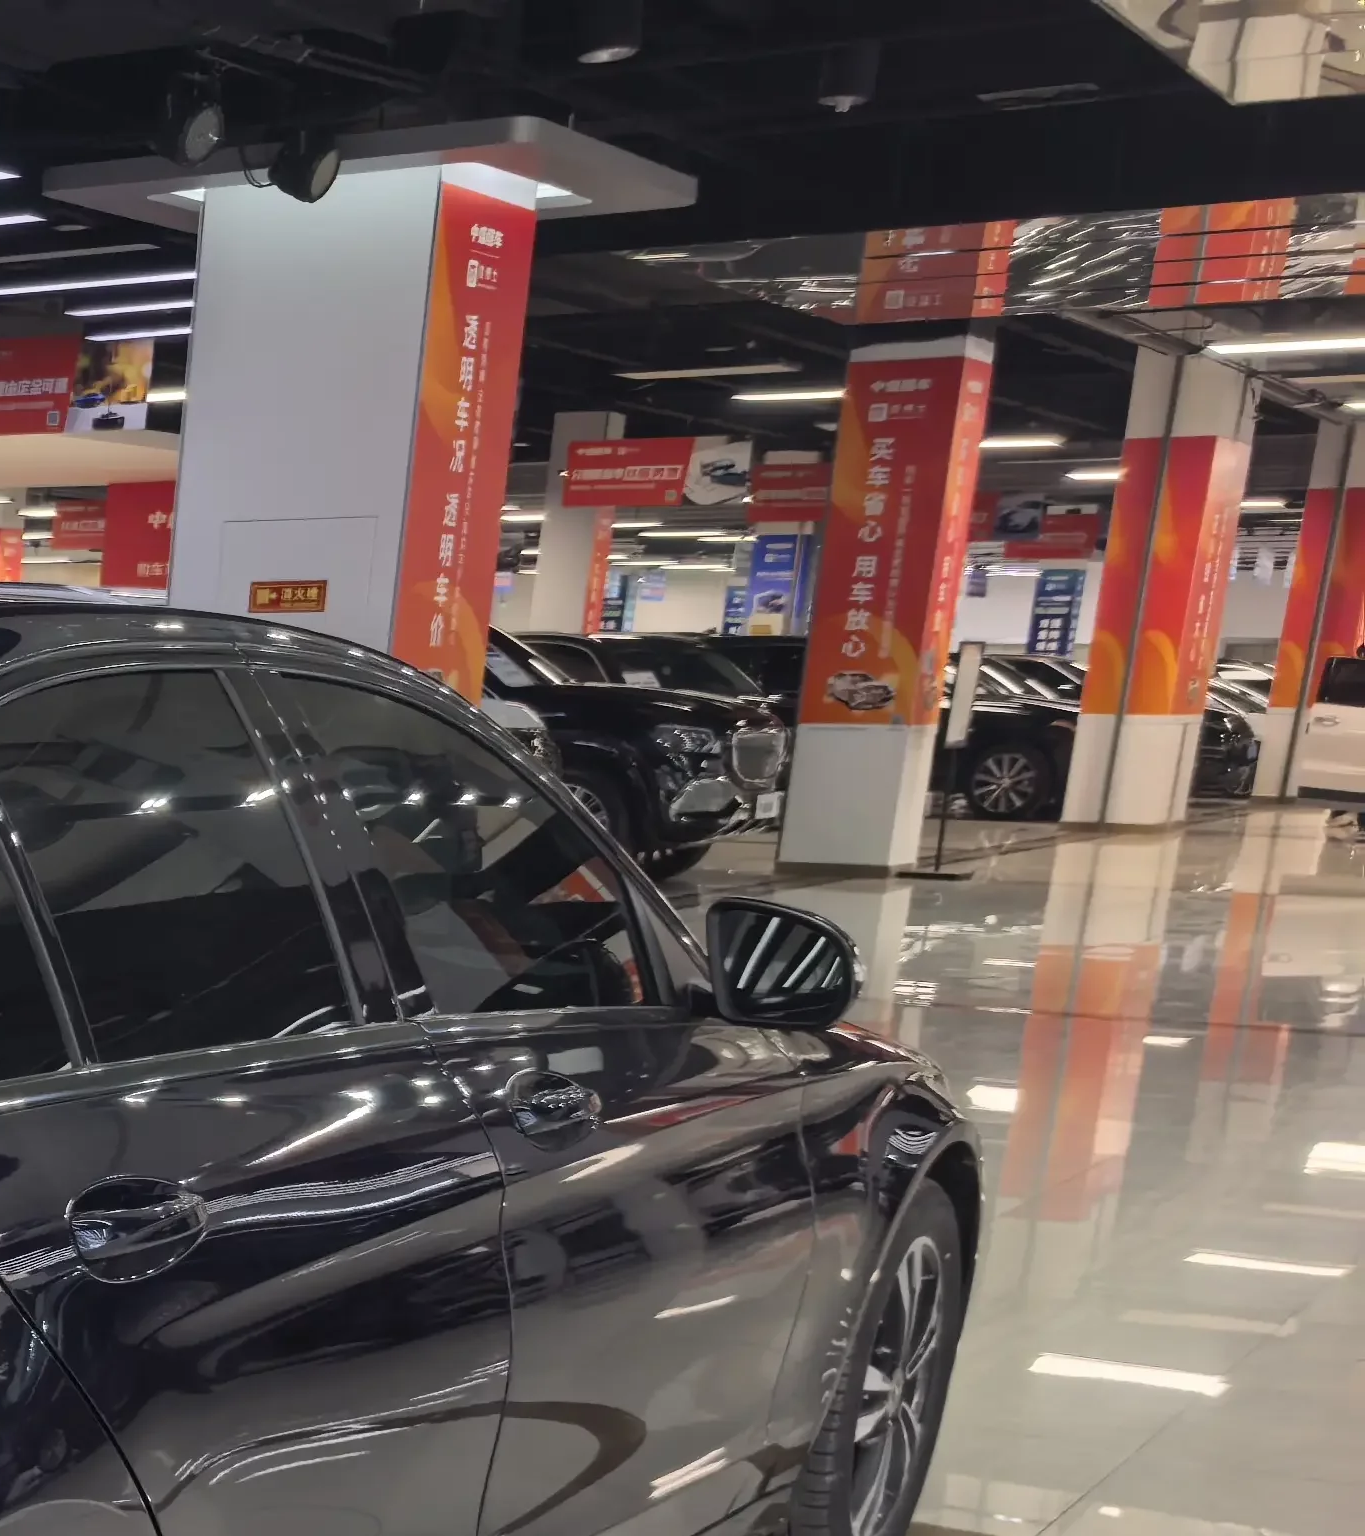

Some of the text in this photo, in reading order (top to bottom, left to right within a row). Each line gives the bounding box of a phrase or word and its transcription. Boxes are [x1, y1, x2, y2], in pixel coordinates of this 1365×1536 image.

[449, 314, 480, 473] 透明车况
[429, 492, 461, 648] 透明车价
[840, 437, 897, 658] 买车省心 用车放心
